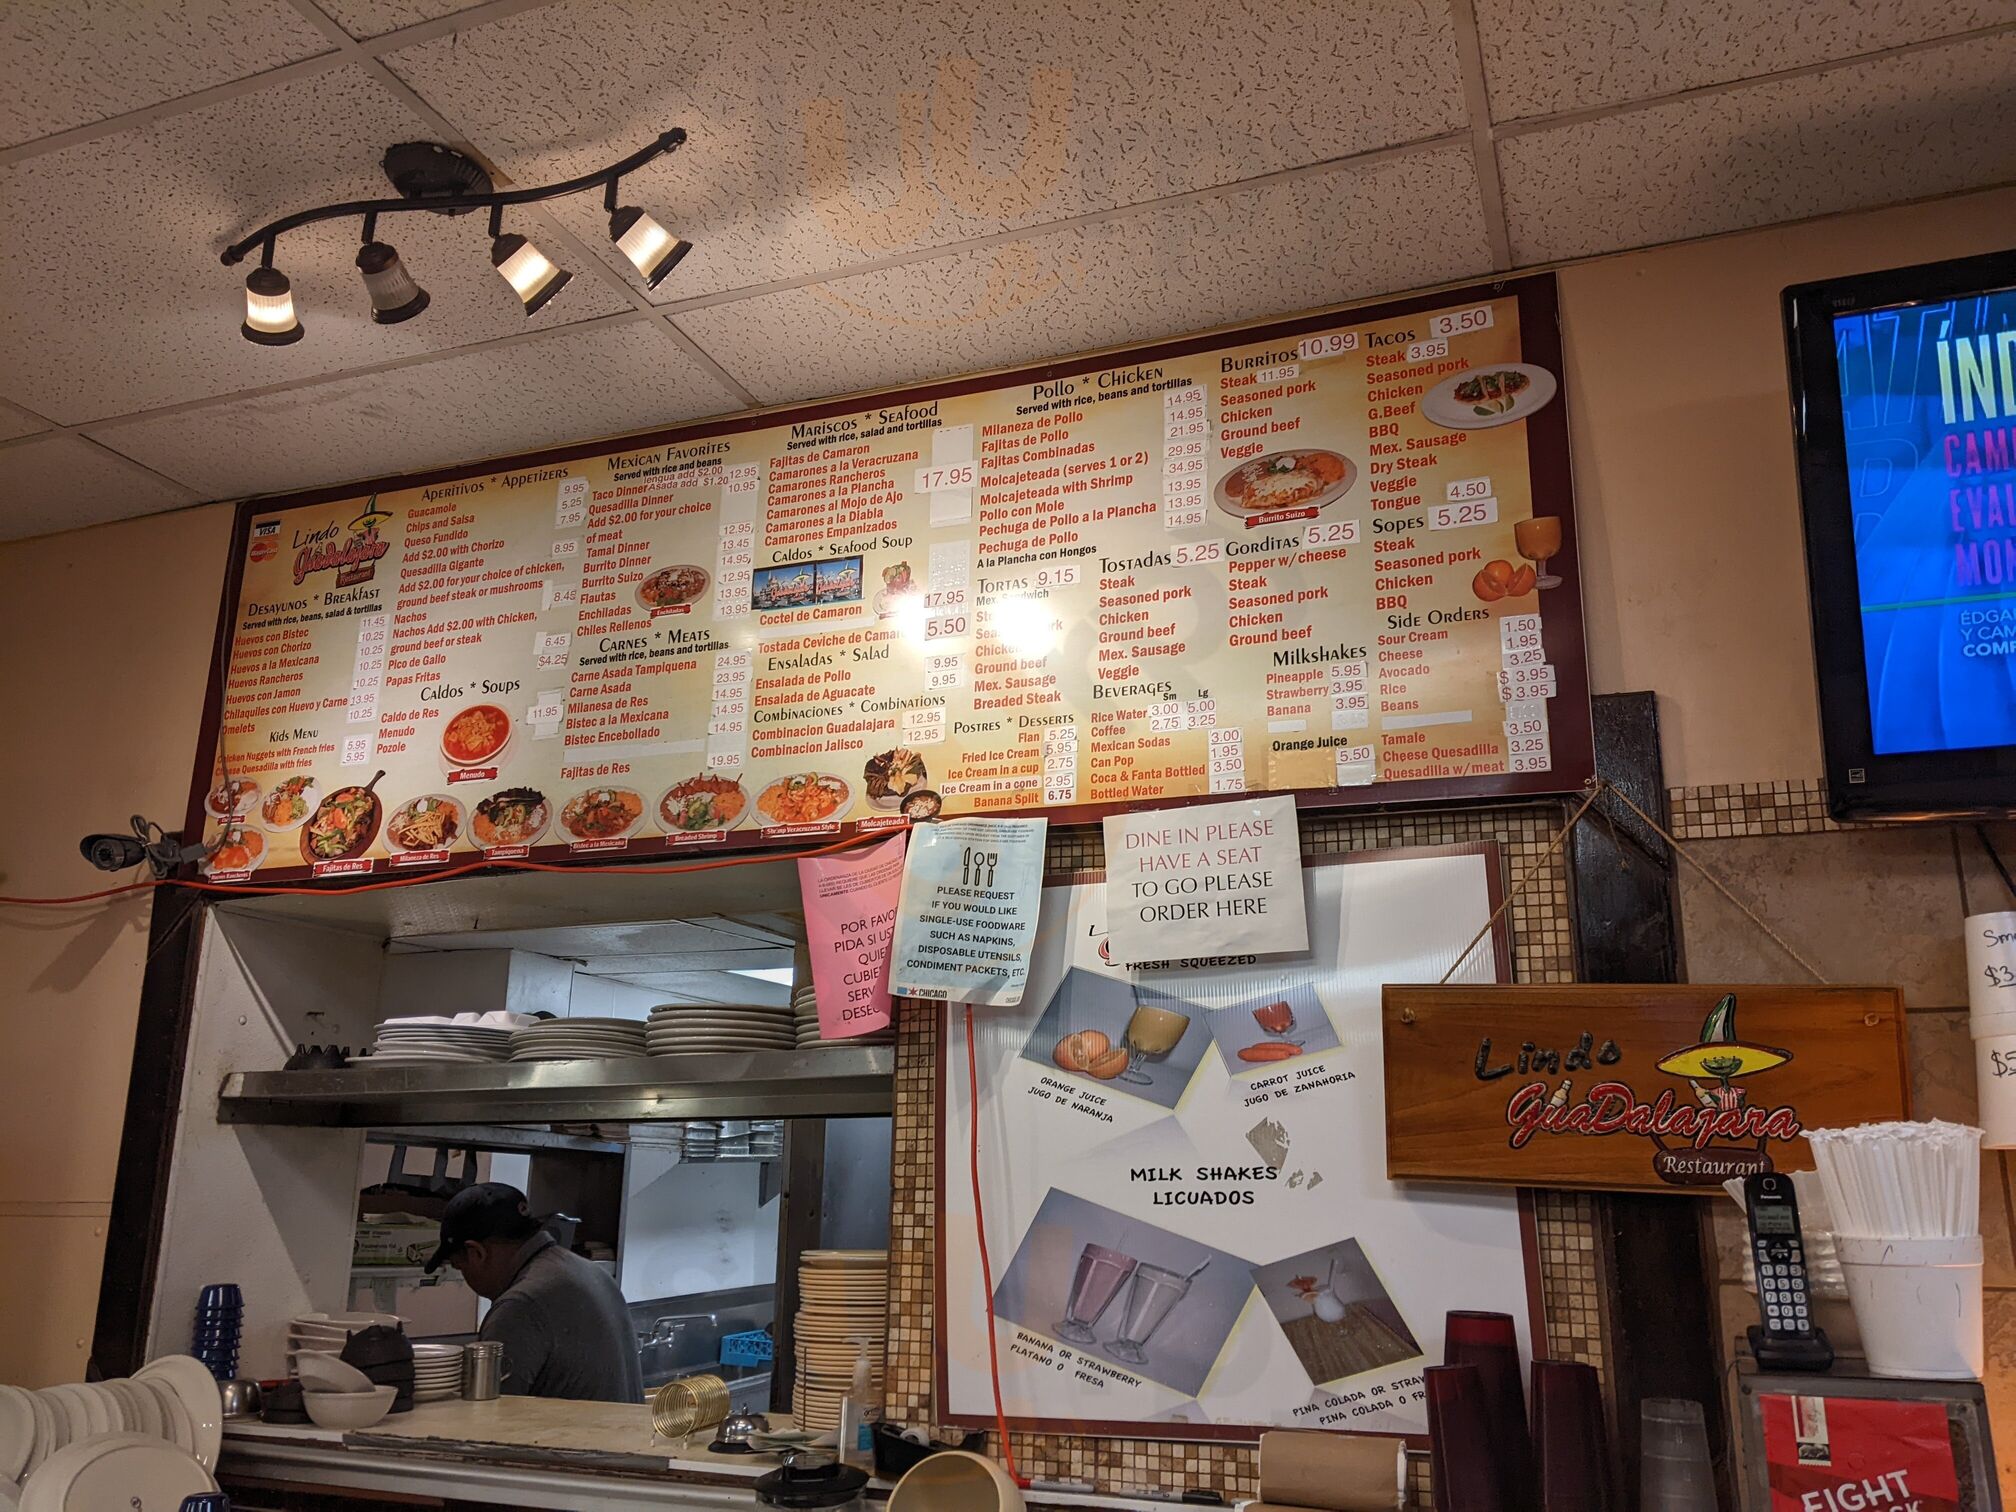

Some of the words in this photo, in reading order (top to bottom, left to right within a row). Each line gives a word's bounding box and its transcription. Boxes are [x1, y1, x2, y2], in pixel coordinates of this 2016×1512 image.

[1439, 311, 1486, 333] 3.50
[1298, 334, 1357, 356] 10.99
[1016, 401, 1049, 415] Served
[1051, 397, 1071, 409] with
[1098, 389, 1128, 401] beans
[1130, 383, 1149, 396] and
[1151, 377, 1192, 392] tortillas
[1220, 422, 1267, 440] Ground
[1271, 417, 1300, 433] beef
[1369, 423, 1398, 438] BBQ
[1406, 432, 1466, 450] Sausage
[922, 466, 972, 488] 17.95
[980, 485, 1059, 505] Molcajeteada
[1062, 480, 1087, 493] with
[1090, 474, 1133, 489] Shrimp
[1450, 481, 1486, 497] 4.50
[407, 502, 456, 518] Guacamole
[588, 498, 638, 516] Quesadilla
[641, 494, 673, 506] Dinner
[1370, 495, 1420, 510] Tongue
[405, 521, 430, 533] Chips
[431, 516, 449, 529] and
[450, 514, 474, 526] Salsa
[1258, 513, 1284, 523] Burrito
[1285, 511, 1305, 519] Suizo
[401, 551, 420, 563] Add
[421, 546, 448, 560] $2.00
[449, 543, 468, 555] with
[470, 539, 504, 552] Chorizo
[552, 542, 574, 553] 8.95
[583, 559, 616, 573] Burrito
[618, 556, 651, 568] Dinner
[1038, 568, 1073, 585] 9.15
[1099, 589, 1159, 608] Seasoned
[1163, 585, 1191, 602] pork
[1377, 634, 1405, 646] Sour
[1408, 630, 1448, 642] Cream
[536, 653, 569, 667] $4.25
[716, 654, 745, 667] 24.95
[754, 692, 803, 707] Ensalada
[806, 690, 820, 701] de
[822, 685, 875, 701] Aguacate
[380, 711, 407, 723] Caldo
[408, 709, 420, 720] de
[421, 707, 439, 718] Res
[1272, 739, 1314, 751] Orange
[1316, 735, 1347, 748] Juice
[962, 751, 986, 763] Fried
[988, 750, 1004, 761] Ice
[1006, 748, 1039, 759] Cream
[1382, 750, 1428, 762] Cheese
[1431, 743, 1498, 760] Quesadilla
[1514, 756, 1549, 771] 3.95
[459, 771, 485, 779] Menudo
[1090, 773, 1116, 784] Coca
[1119, 770, 1128, 782] &
[1131, 768, 1161, 780] Fanta
[1165, 764, 1205, 778] Bottled
[1048, 789, 1071, 801] 6.75
[860, 817, 907, 827] Molcajeteada
[1126, 829, 1171, 849] DINE
[1178, 827, 1198, 844] IN
[1206, 819, 1274, 841] PLEASE
[322, 864, 342, 872] Fajitas
[342, 863, 351, 871] de
[351, 862, 363, 870] Res
[1139, 852, 1190, 872] HAVE
[1196, 851, 1210, 867] A
[1217, 845, 1261, 865] SEAT
[1132, 881, 1158, 897] TO
[1164, 877, 1197, 895] GO
[1204, 870, 1272, 891] PLEASE
[936, 886, 972, 897] PLEASE
[973, 889, 1014, 900] REQUEST
[942, 901, 961, 911] YOU
[963, 903, 996, 914] WOULD
[998, 906, 1016, 915] LIKE
[1140, 902, 1209, 922] ORDER
[1216, 897, 1267, 916] HERE
[841, 921, 867, 934] POR
[919, 914, 974, 926] SINGLE-USE
[975, 919, 1026, 930] FOODWARE
[834, 938, 864, 953] PIDA
[868, 934, 876, 946] SI
[929, 930, 955, 940] SUCH
[957, 933, 970, 942] AS
[917, 944, 976, 957] DISPOSABLE
[906, 959, 963, 971] CONDIMENT
[1179, 955, 1256, 968] SQUEEZED
[917, 989, 947, 998] CHICAGO
[1475, 1031, 1622, 1081] Lindo
[1250, 1074, 1288, 1090] CARROT
[1296, 1065, 1325, 1080] JUICE
[1040, 1076, 1076, 1094] ORANGE
[1078, 1091, 1107, 1105] JUICE
[1244, 1093, 1268, 1107] JUGO
[1274, 1088, 1288, 1098] DE
[1293, 1072, 1355, 1093] ZANAHORIA
[1027, 1086, 1051, 1099] JUGO
[1054, 1095, 1067, 1105] DE
[1070, 1102, 1112, 1122] NARANJA
[1130, 1167, 1182, 1181] MILK
[1196, 1166, 1277, 1180] SHAKES
[1663, 1155, 1765, 1175] Restaurant
[1153, 1190, 1254, 1205] LICUADOS
[1010, 1344, 1052, 1366] PLATANO
[1074, 1370, 1103, 1387] FRESA
[1016, 1331, 1053, 1352] BANANA
[1058, 1349, 1072, 1359] OR
[1076, 1357, 1141, 1386] STRAWBERRY
[1292, 1403, 1319, 1415] PINA
[1324, 1391, 1365, 1408] COLADA
[1371, 1386, 1386, 1396] OR
[1319, 1411, 1346, 1424] PINA
[1351, 1400, 1393, 1416] COLADA
